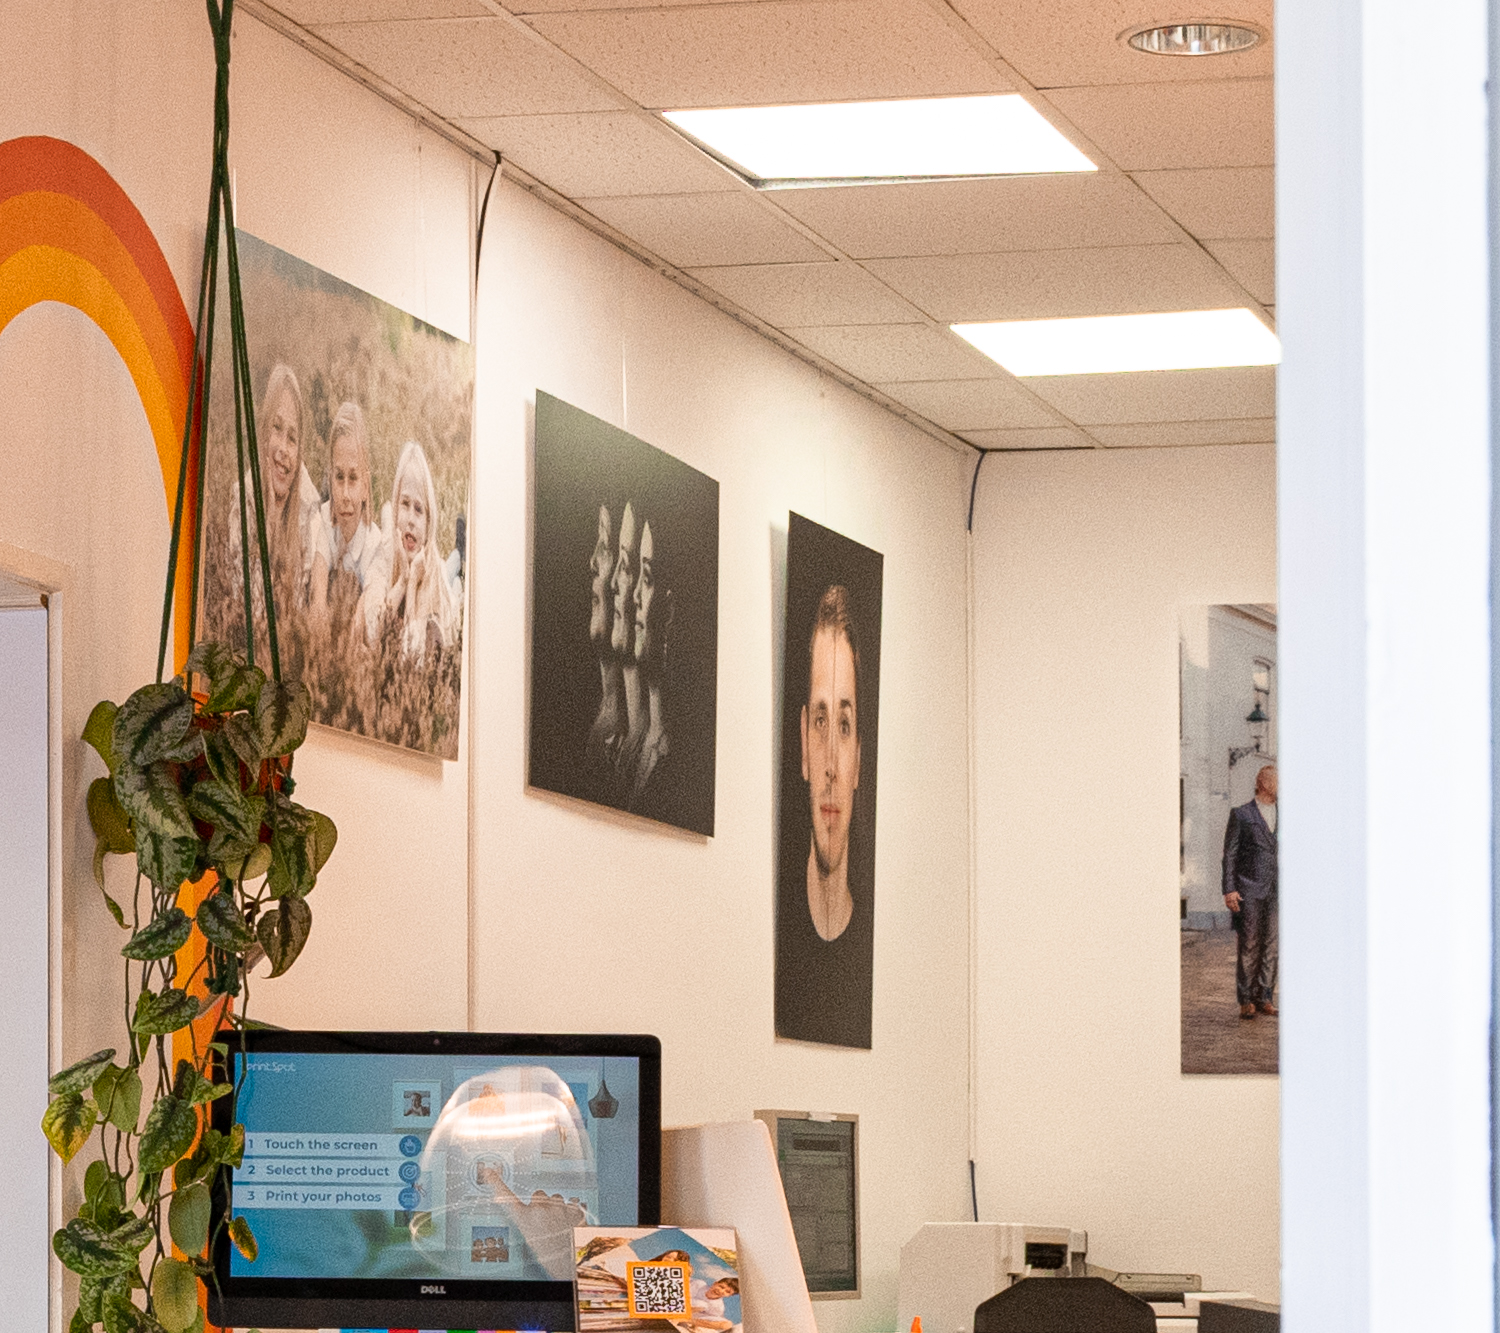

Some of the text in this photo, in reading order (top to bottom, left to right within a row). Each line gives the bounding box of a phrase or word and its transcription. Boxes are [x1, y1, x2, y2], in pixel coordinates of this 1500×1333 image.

[264, 1139, 304, 1150] Touch
[308, 1139, 332, 1150] the
[334, 1141, 378, 1150] screen
[248, 1165, 390, 1181] 2 Select the product
[247, 1191, 382, 1204] 3 Print your photos
[420, 1285, 447, 1295] DELL
